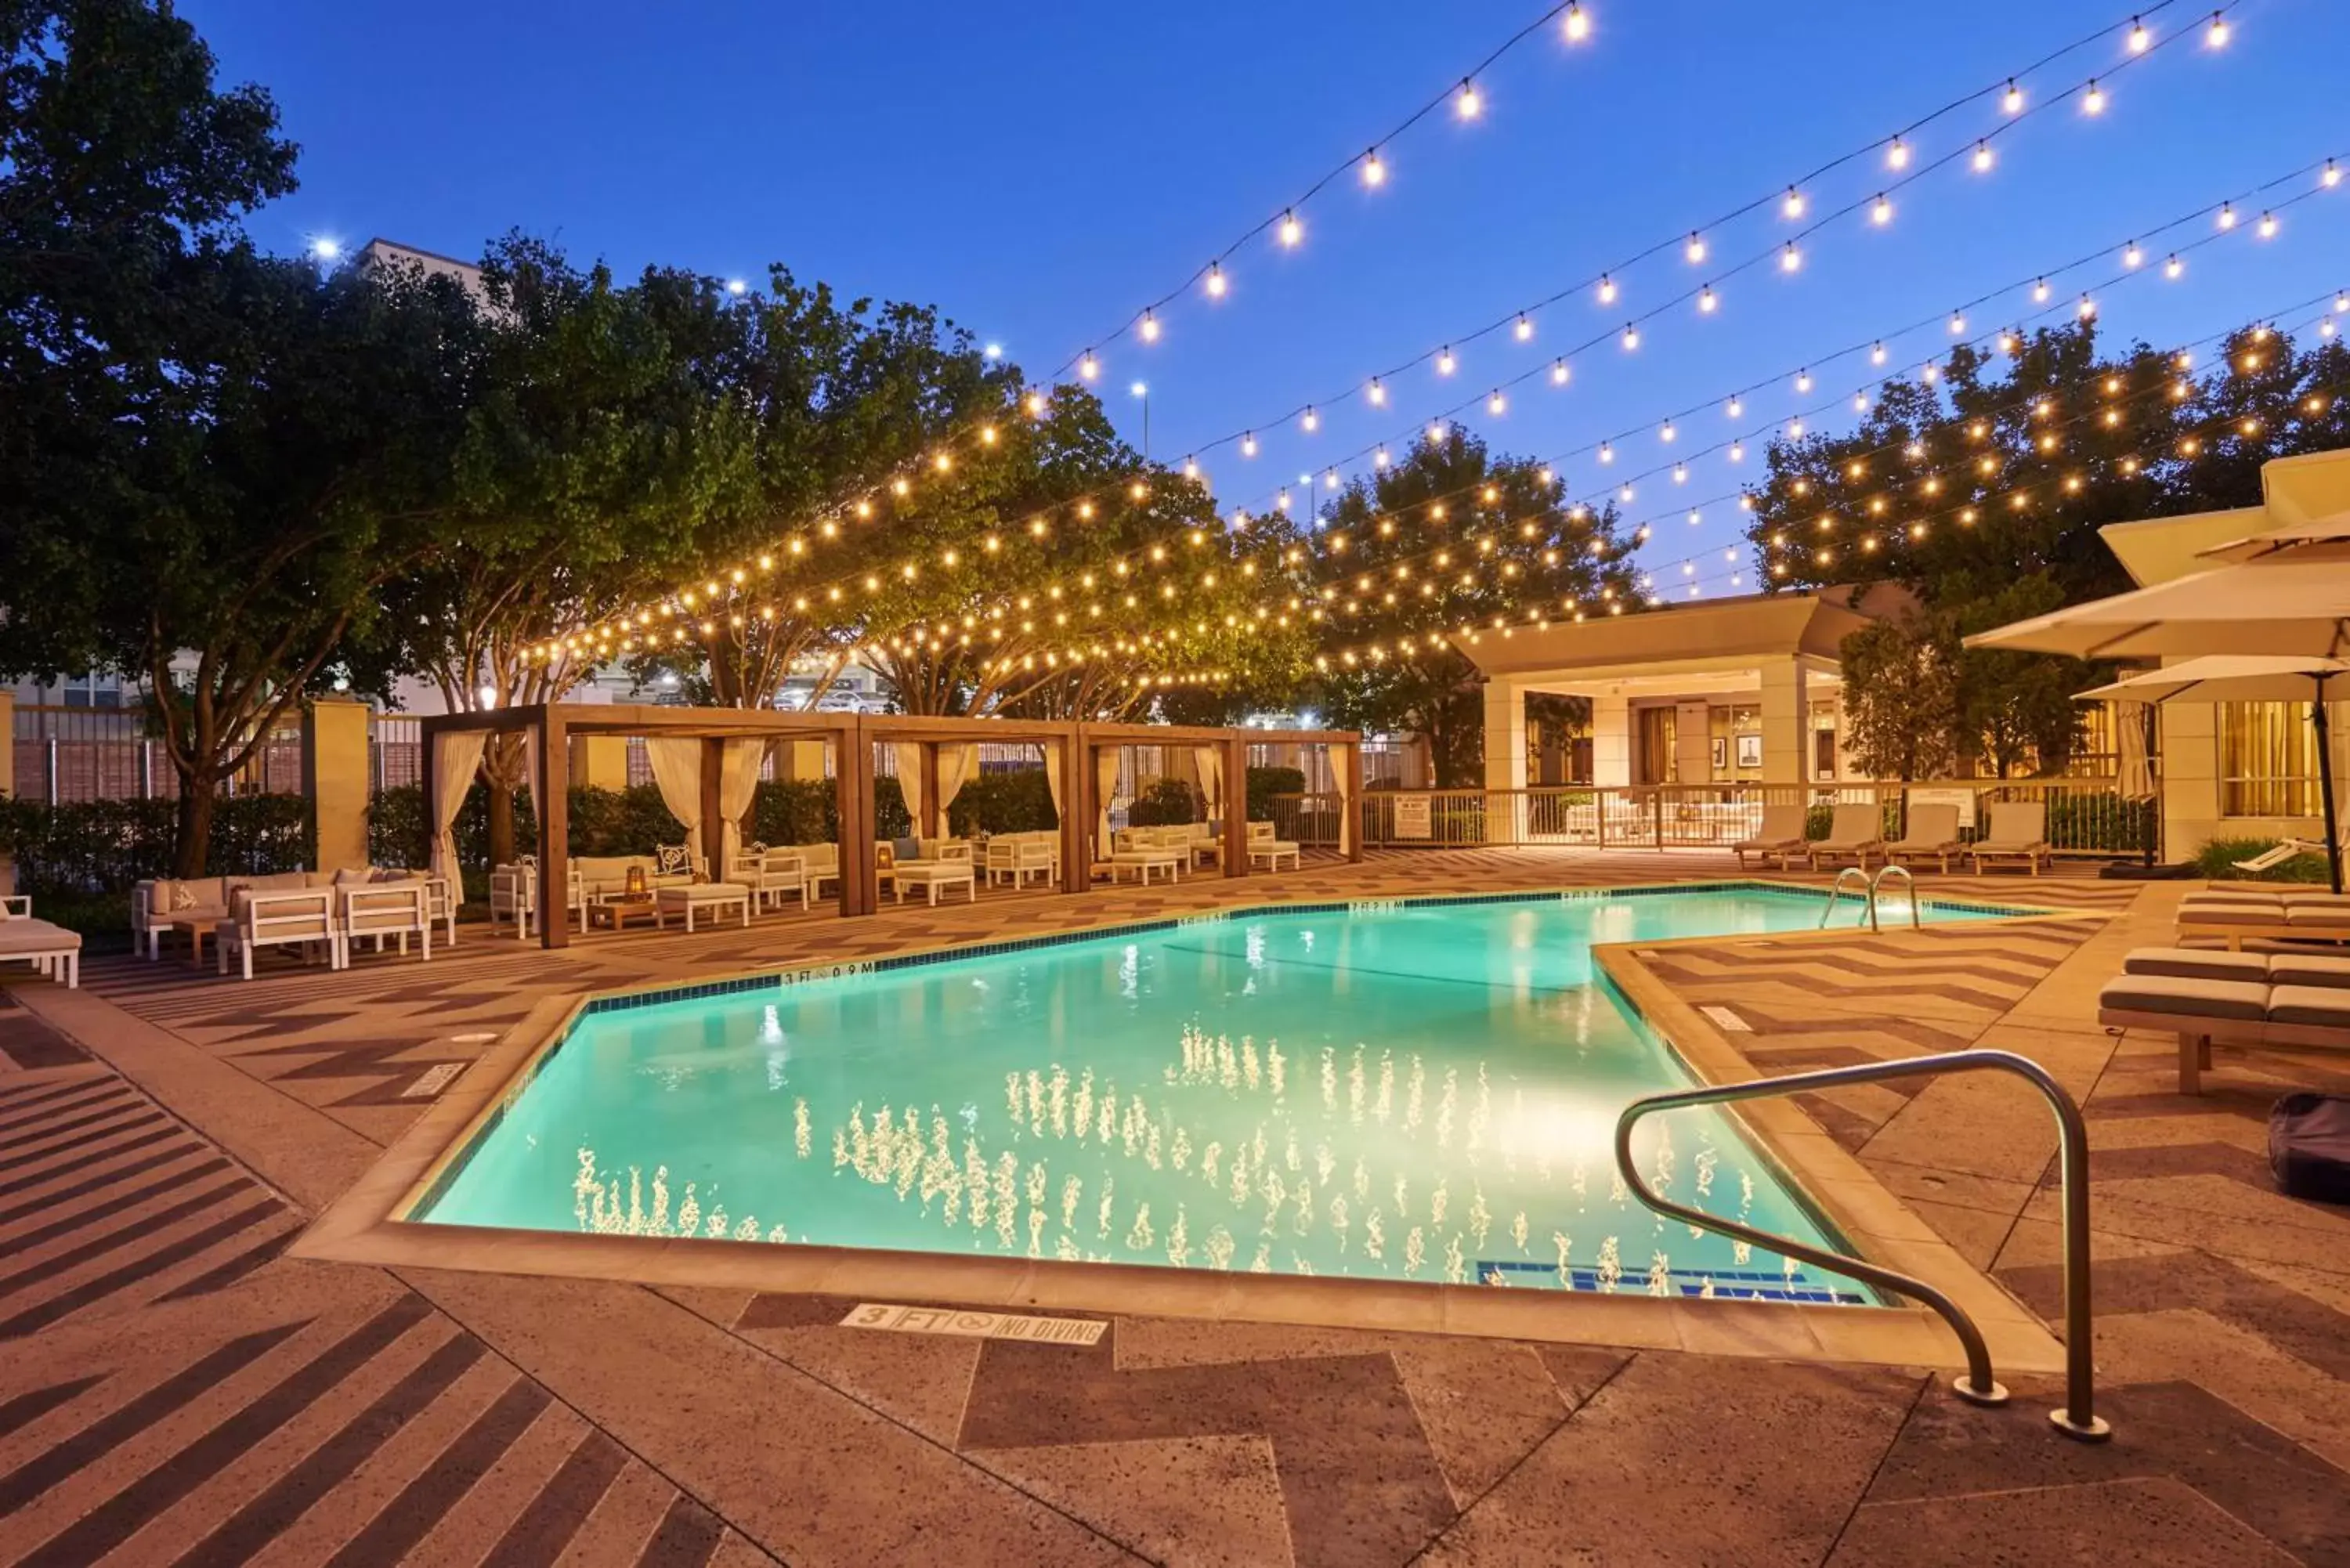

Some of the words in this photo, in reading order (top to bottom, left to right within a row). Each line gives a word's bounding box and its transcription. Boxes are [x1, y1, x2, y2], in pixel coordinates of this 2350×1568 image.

[800, 970, 811, 983] FT
[862, 962, 873, 974] M
[859, 1307, 888, 1324] 3
[898, 1310, 949, 1329] FT
[1000, 1318, 1027, 1335] NO
[1034, 1321, 1101, 1341] DIVING
